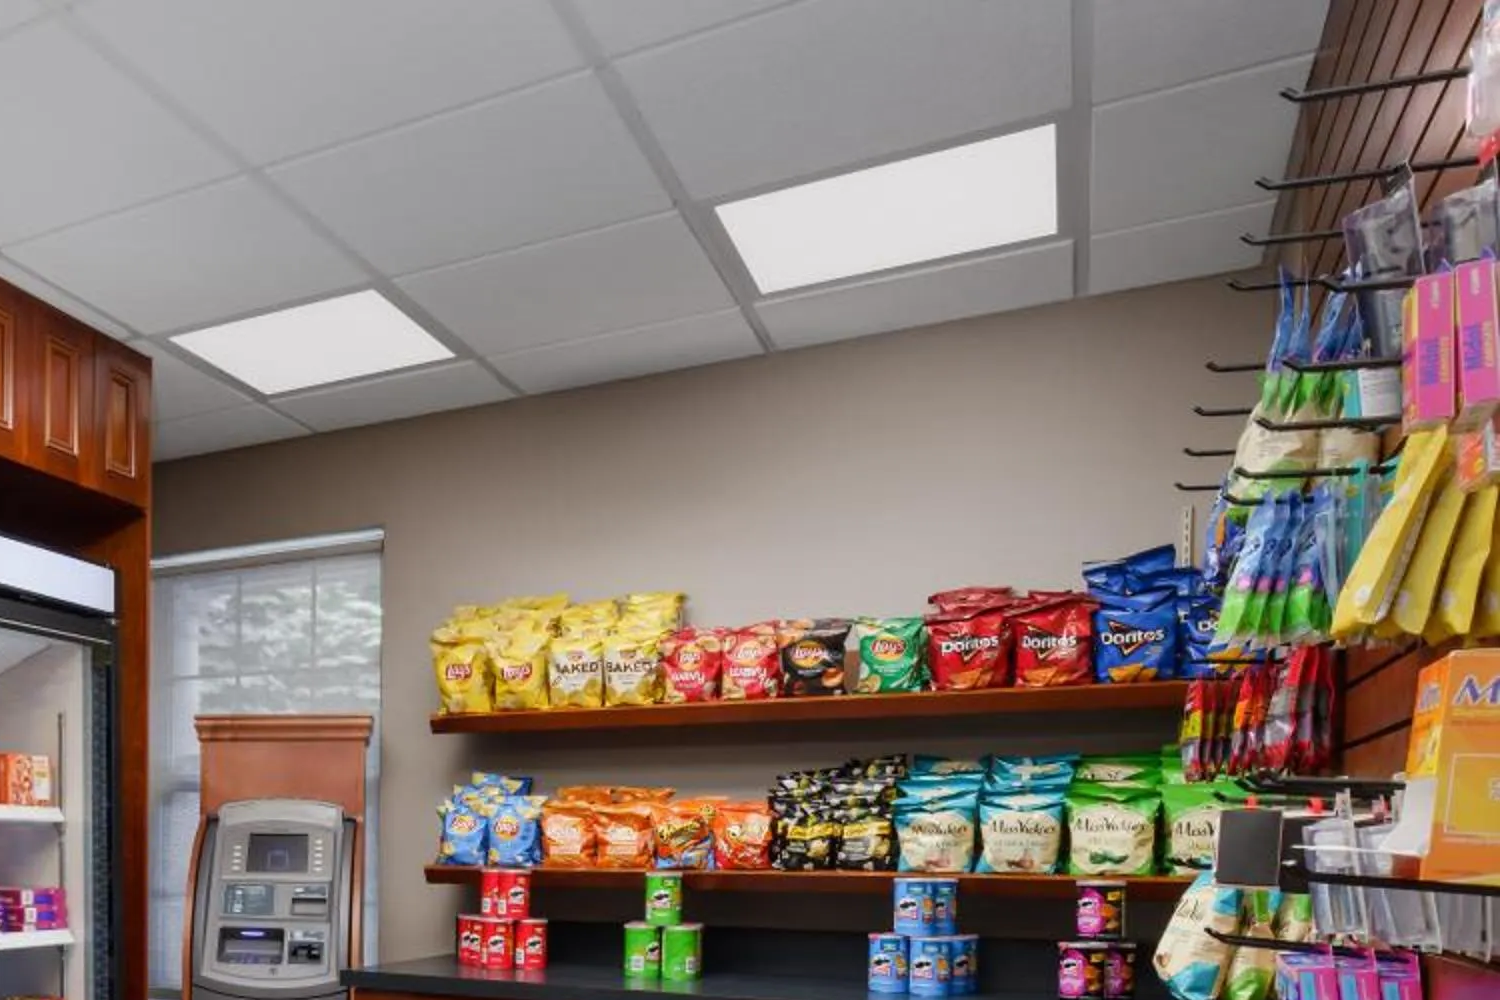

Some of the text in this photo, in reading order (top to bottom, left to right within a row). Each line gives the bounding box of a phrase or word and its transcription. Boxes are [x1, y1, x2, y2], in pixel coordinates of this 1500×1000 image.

[941, 635, 999, 655] Doritos
[1023, 635, 1076, 650] Doritos
[1101, 628, 1164, 645] Doritos
